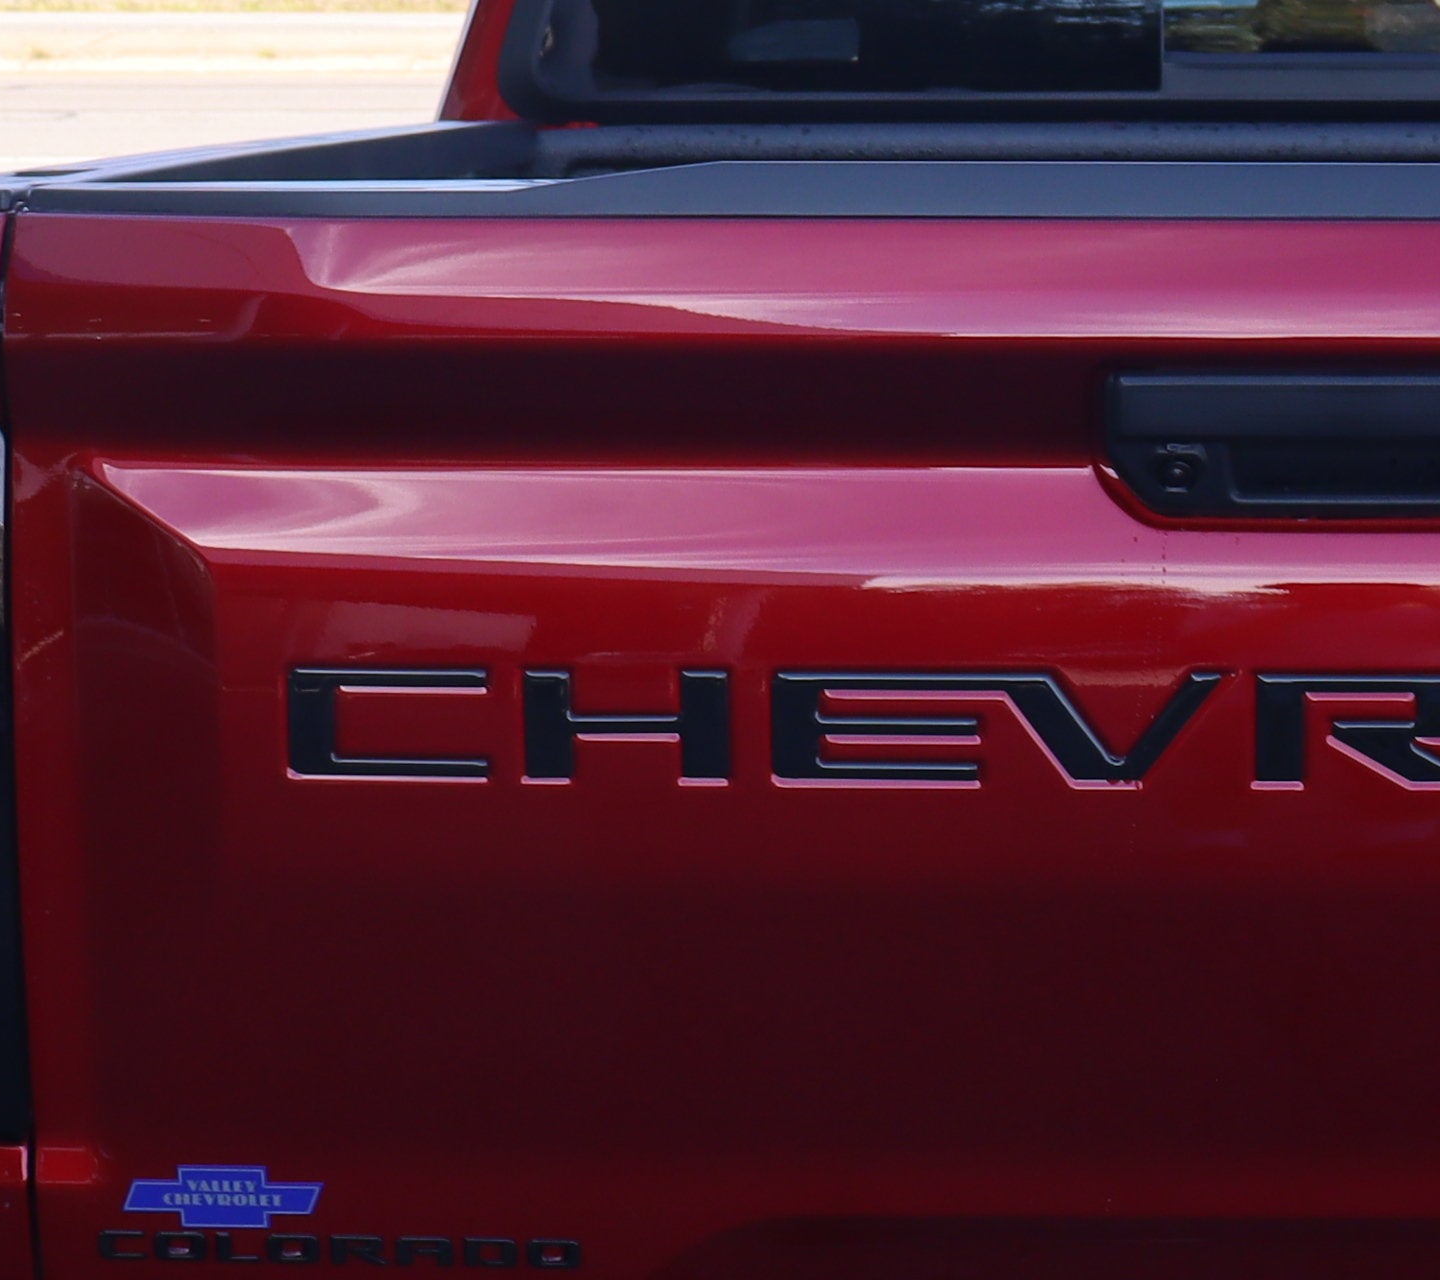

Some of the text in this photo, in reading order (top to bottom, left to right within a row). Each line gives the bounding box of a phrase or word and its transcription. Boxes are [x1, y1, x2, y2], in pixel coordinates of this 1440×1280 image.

[186, 1179, 257, 1193] VALLEY
[163, 1192, 283, 1207] CHEVROLET
[99, 1230, 580, 1269] COLORADO
